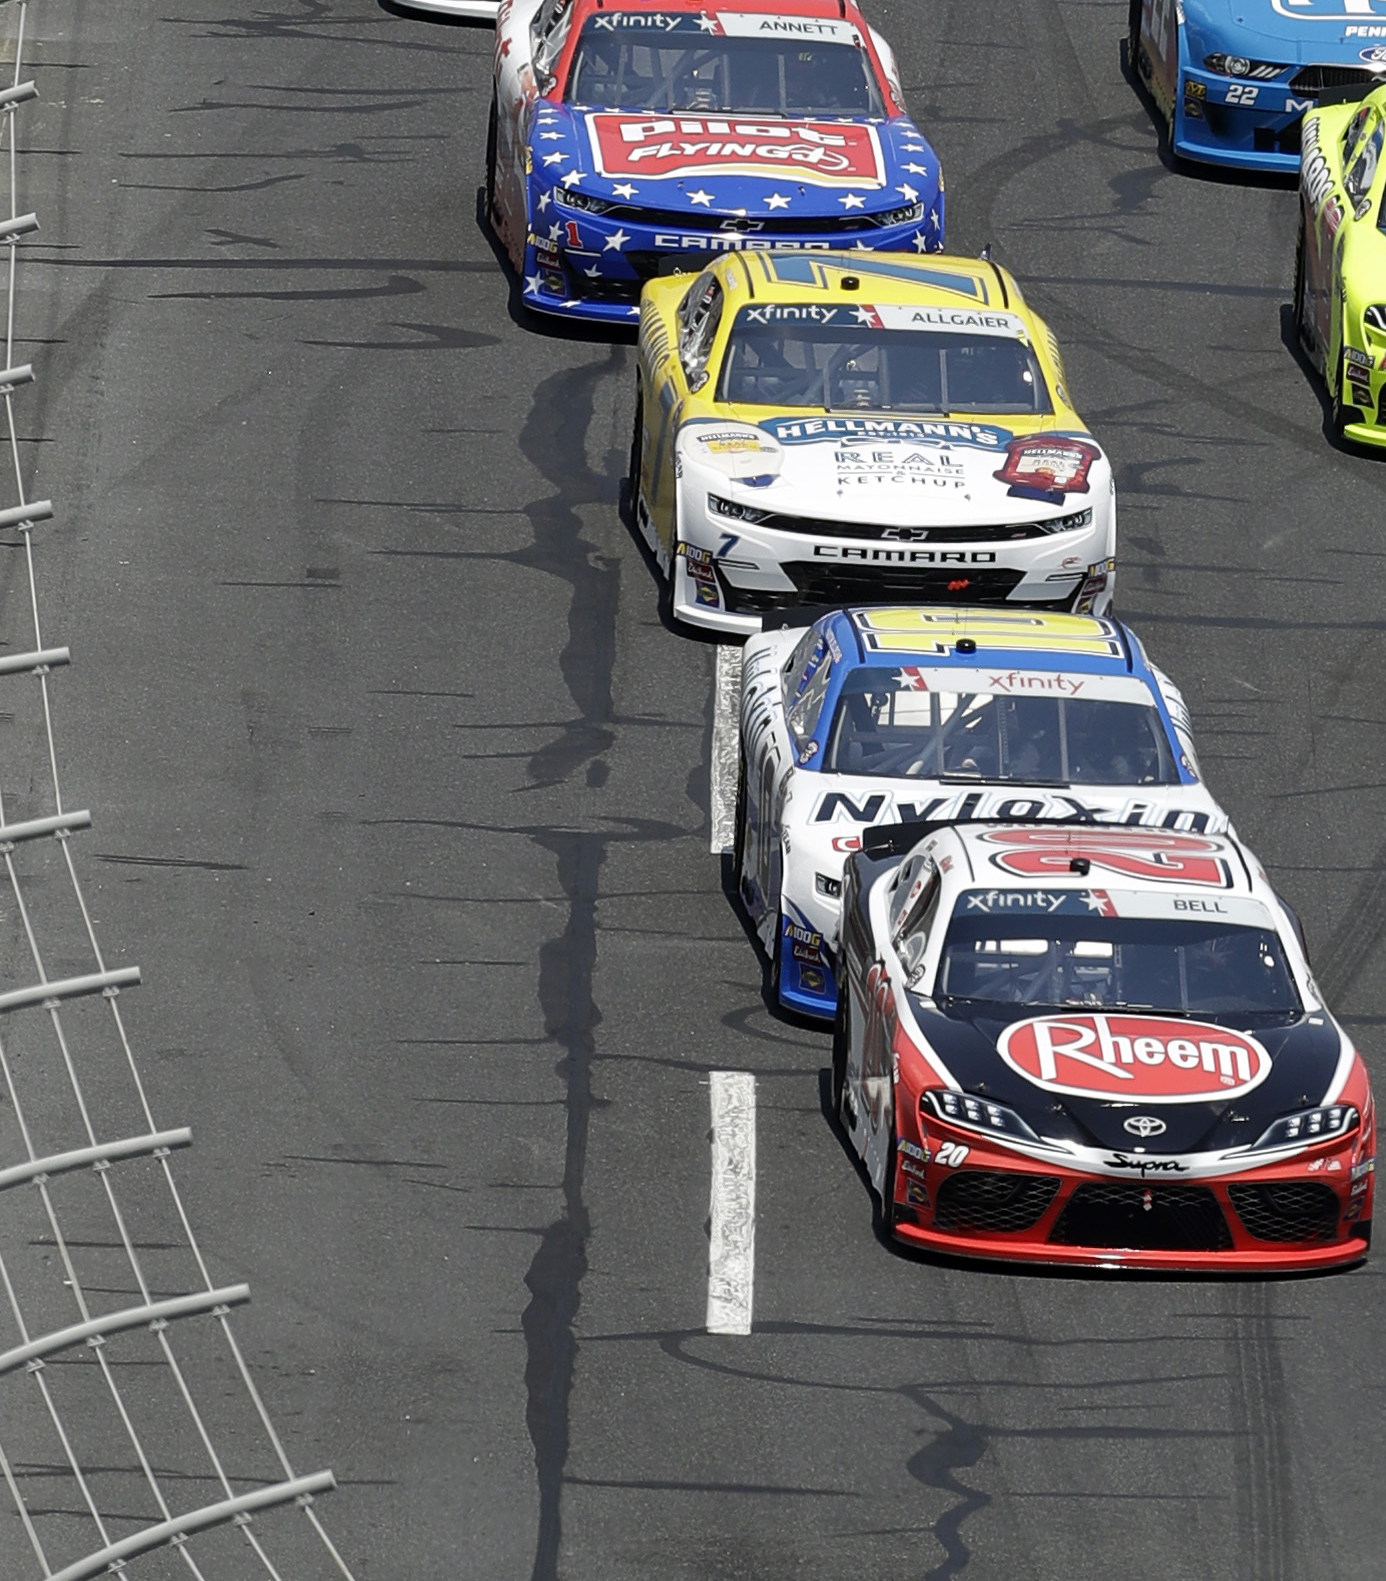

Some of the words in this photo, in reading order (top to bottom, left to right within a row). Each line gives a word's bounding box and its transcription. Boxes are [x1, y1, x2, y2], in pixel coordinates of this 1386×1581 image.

[594, 12, 682, 31] xfinity
[759, 19, 839, 36] ANNETT
[1224, 84, 1260, 105] 22
[565, 222, 584, 248] 1
[654, 235, 830, 250] CAMARO
[746, 304, 839, 325] xfinity
[911, 311, 1011, 330] ALLGAIER
[776, 418, 1000, 447] HELLMANN'S
[832, 450, 965, 468] REAL
[836, 463, 965, 475] MAYONNAISE
[837, 476, 966, 489] KETCHUP
[716, 533, 741, 558] 7
[813, 545, 997, 563] CAMARO
[987, 670, 1086, 695] xfinity
[812, 791, 1219, 833] Nyloxin
[965, 890, 1068, 912] xfinity
[1173, 898, 1229, 915] BELL
[1031, 1015, 1252, 1083] Rheem
[934, 1142, 971, 1168] 20
[1103, 1153, 1192, 1178] Supra
